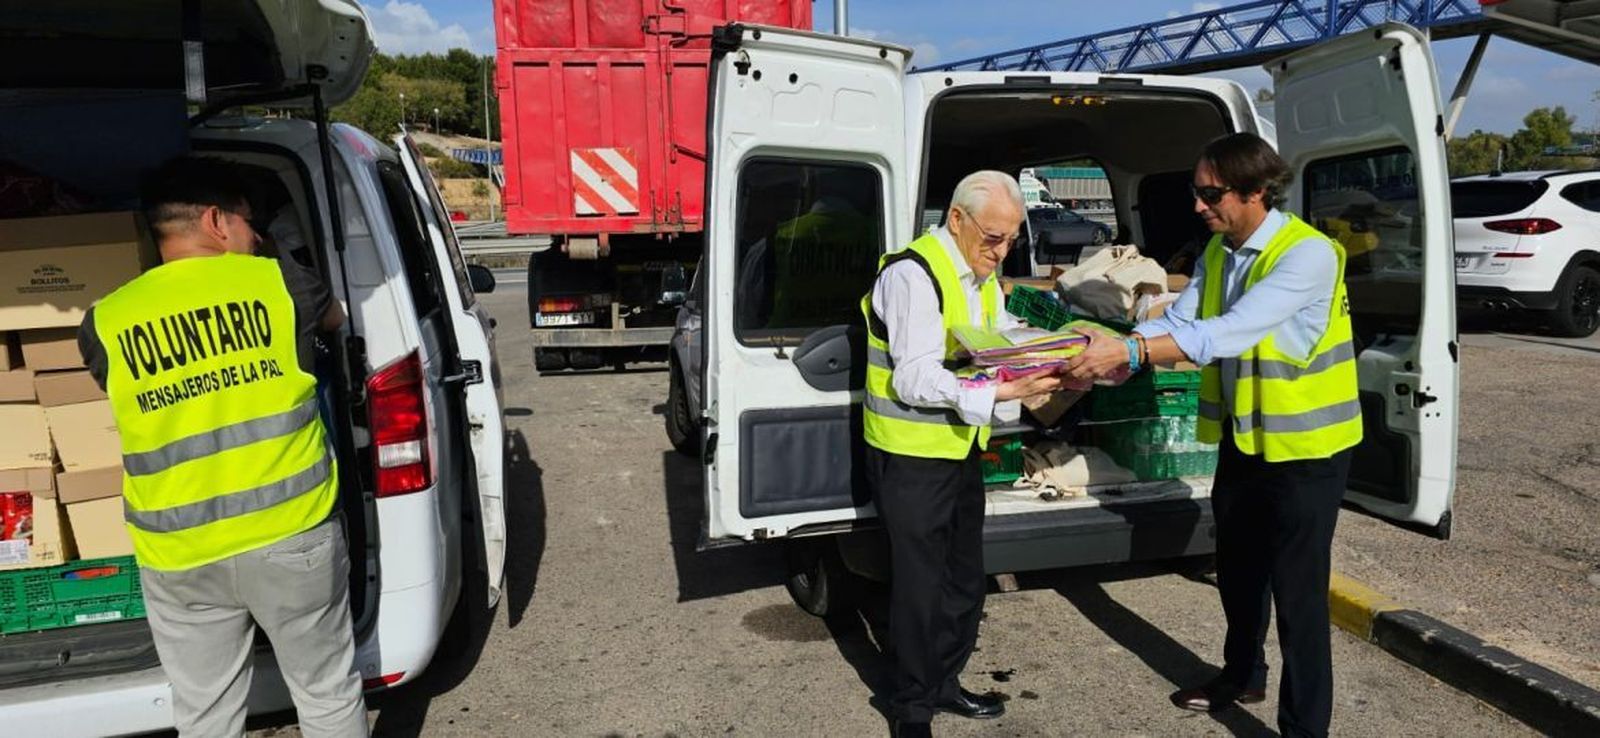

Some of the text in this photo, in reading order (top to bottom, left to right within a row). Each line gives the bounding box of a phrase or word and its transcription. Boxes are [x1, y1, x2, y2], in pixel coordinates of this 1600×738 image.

[117, 299, 272, 381] VOLUNTARIO
[136, 371, 220, 414] MENSAJEROS
[221, 365, 240, 388] DE
[241, 363, 260, 383] LA
